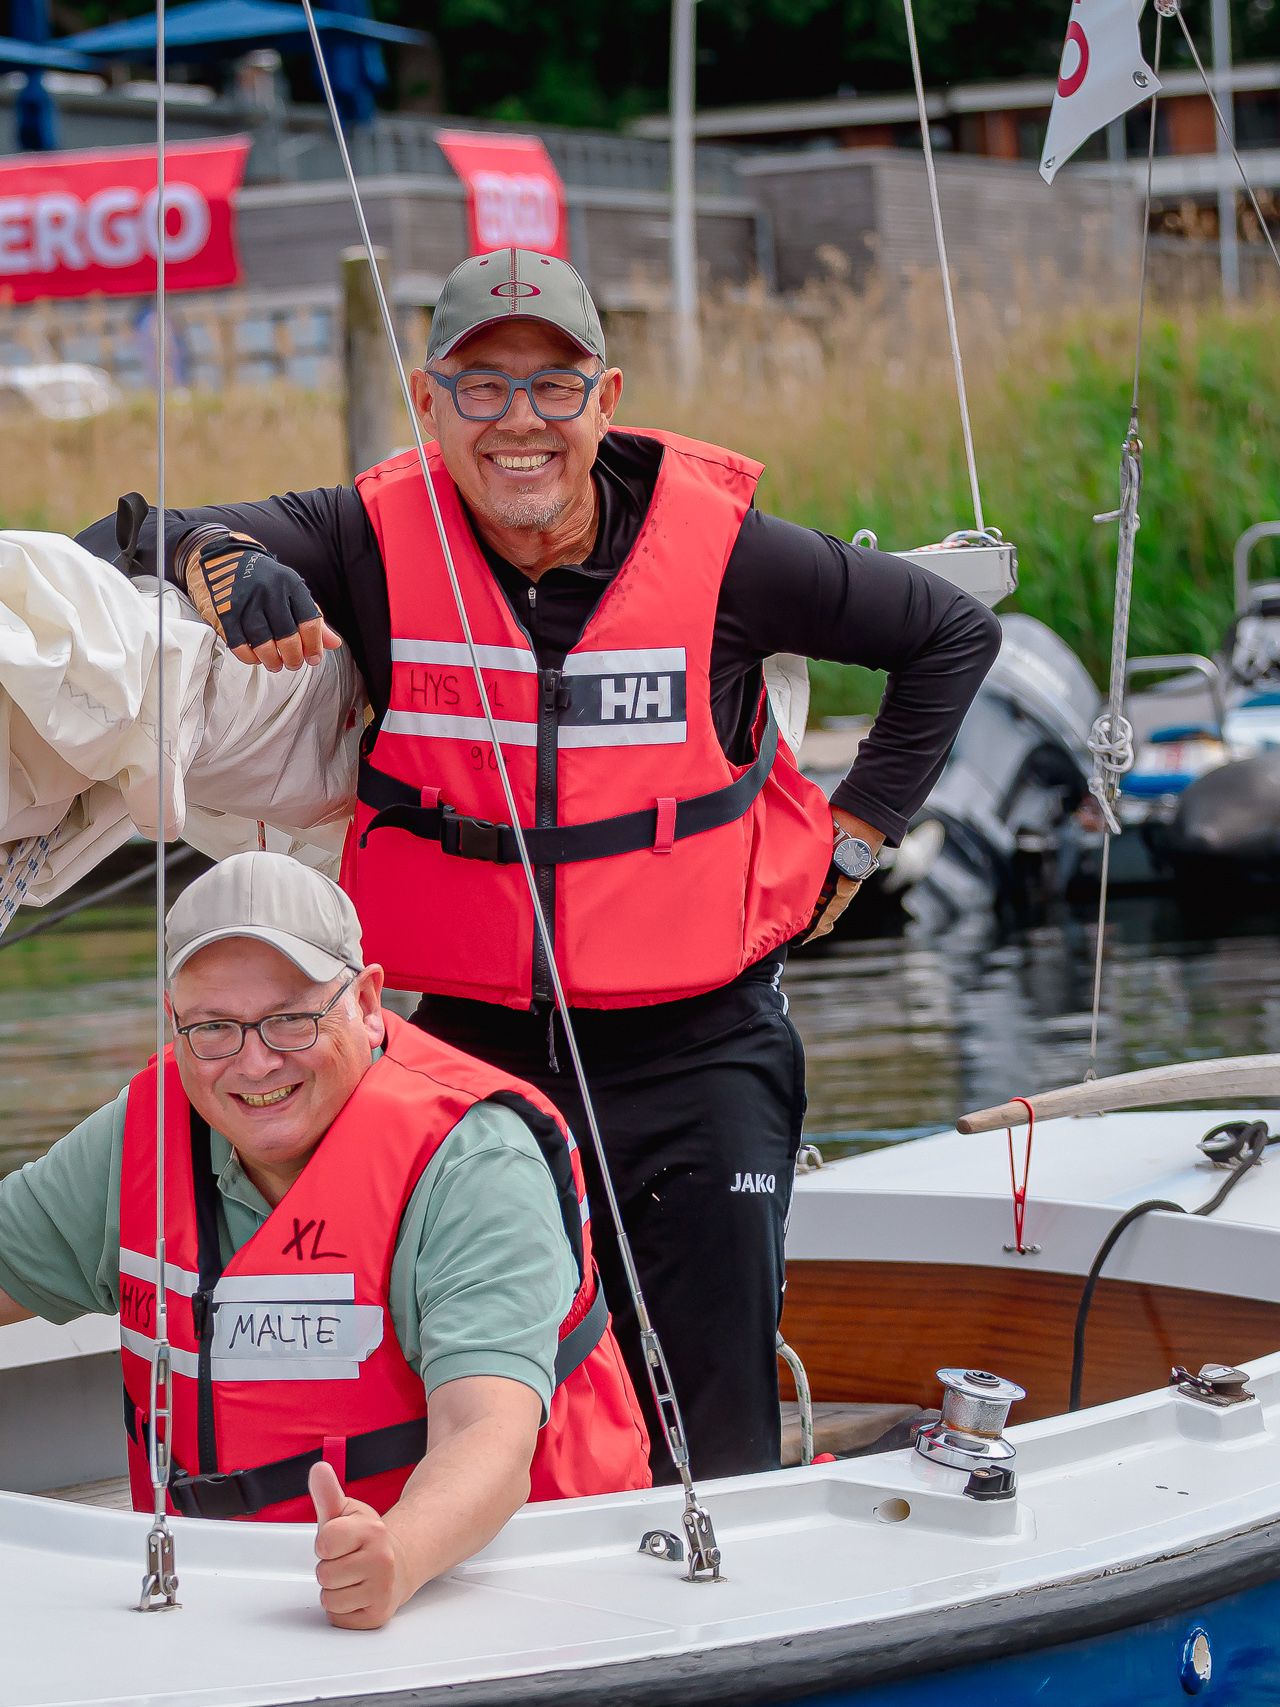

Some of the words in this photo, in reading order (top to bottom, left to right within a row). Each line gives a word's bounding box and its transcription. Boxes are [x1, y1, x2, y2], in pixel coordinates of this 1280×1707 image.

[409, 669, 460, 706] HYS
[600, 676, 672, 720] HH
[730, 1172, 776, 1194] JAKO
[282, 1217, 348, 1261] XL
[122, 1281, 156, 1328] HYS
[228, 1314, 342, 1350] MALTE
